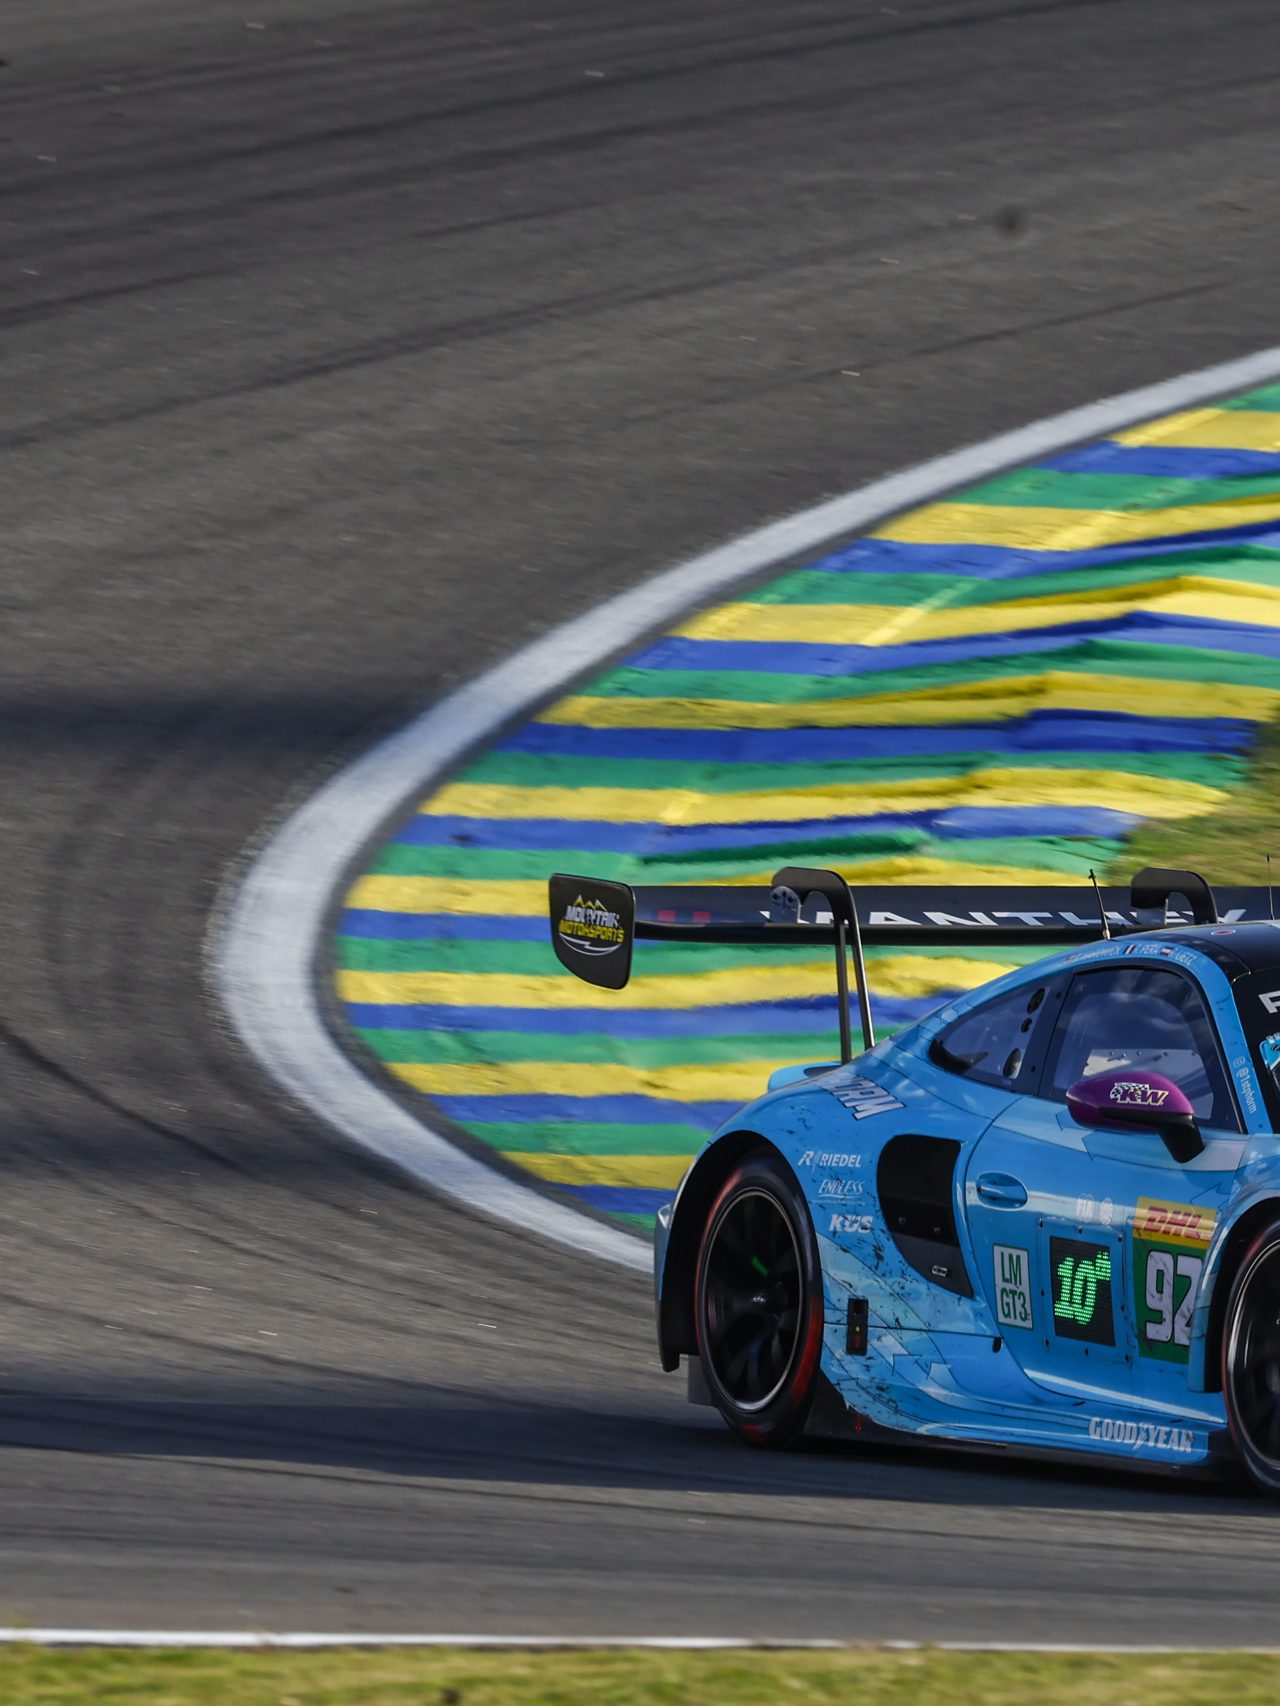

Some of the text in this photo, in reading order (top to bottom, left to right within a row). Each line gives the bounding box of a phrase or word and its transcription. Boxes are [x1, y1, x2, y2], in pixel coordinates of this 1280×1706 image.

[559, 919, 625, 943] MOTORSPORTS
[819, 1153, 862, 1168] RIEDEL
[818, 1179, 865, 1195] ENDLESS
[1143, 1206, 1202, 1239] DHL
[1001, 1251, 1022, 1286] LM
[1000, 1287, 1028, 1322] GT3
[1145, 1249, 1203, 1346] 92
[1088, 1416, 1195, 1453] GOODYEAR
